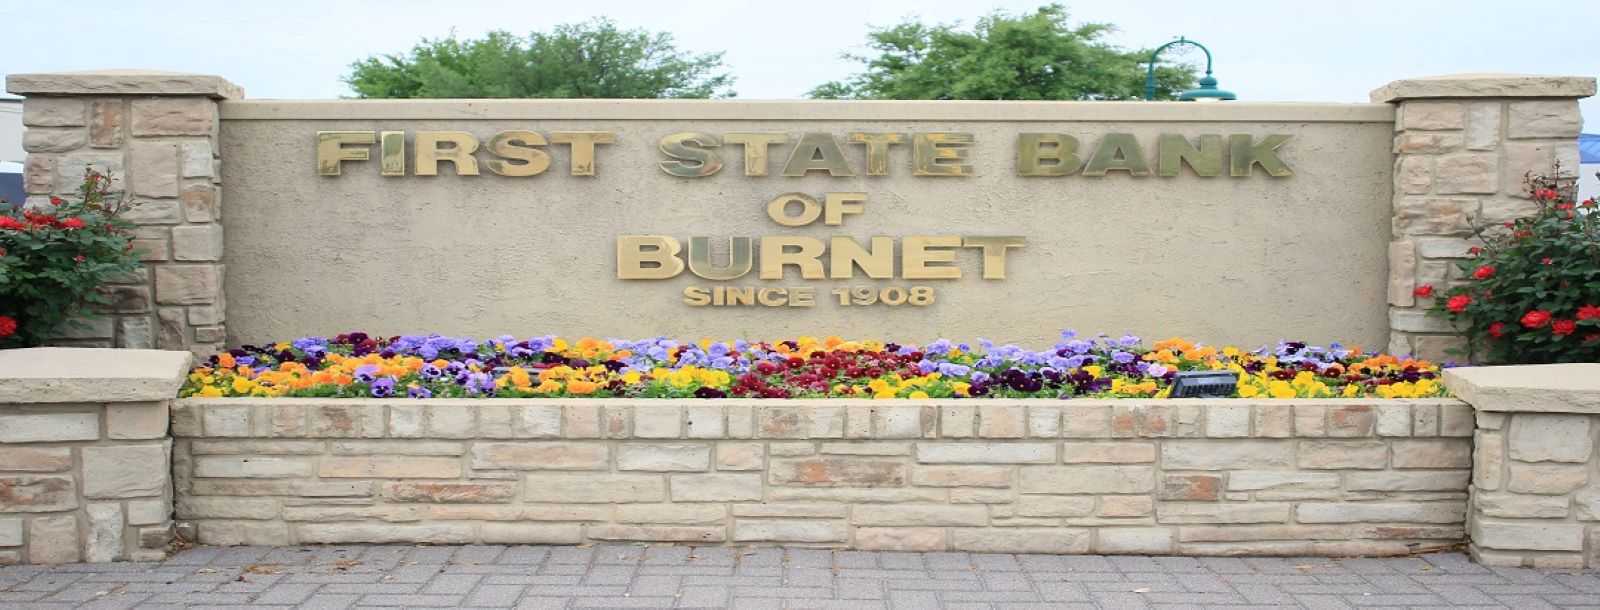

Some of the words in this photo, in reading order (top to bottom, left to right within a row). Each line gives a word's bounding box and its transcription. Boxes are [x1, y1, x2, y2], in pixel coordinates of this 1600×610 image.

[316, 130, 615, 177] FIRST
[658, 131, 974, 177] STATE
[1017, 132, 1296, 177] BANK
[767, 192, 868, 226] OF
[616, 235, 1026, 280] BURNET
[683, 286, 815, 307] SINCE
[832, 286, 935, 307] 1908
